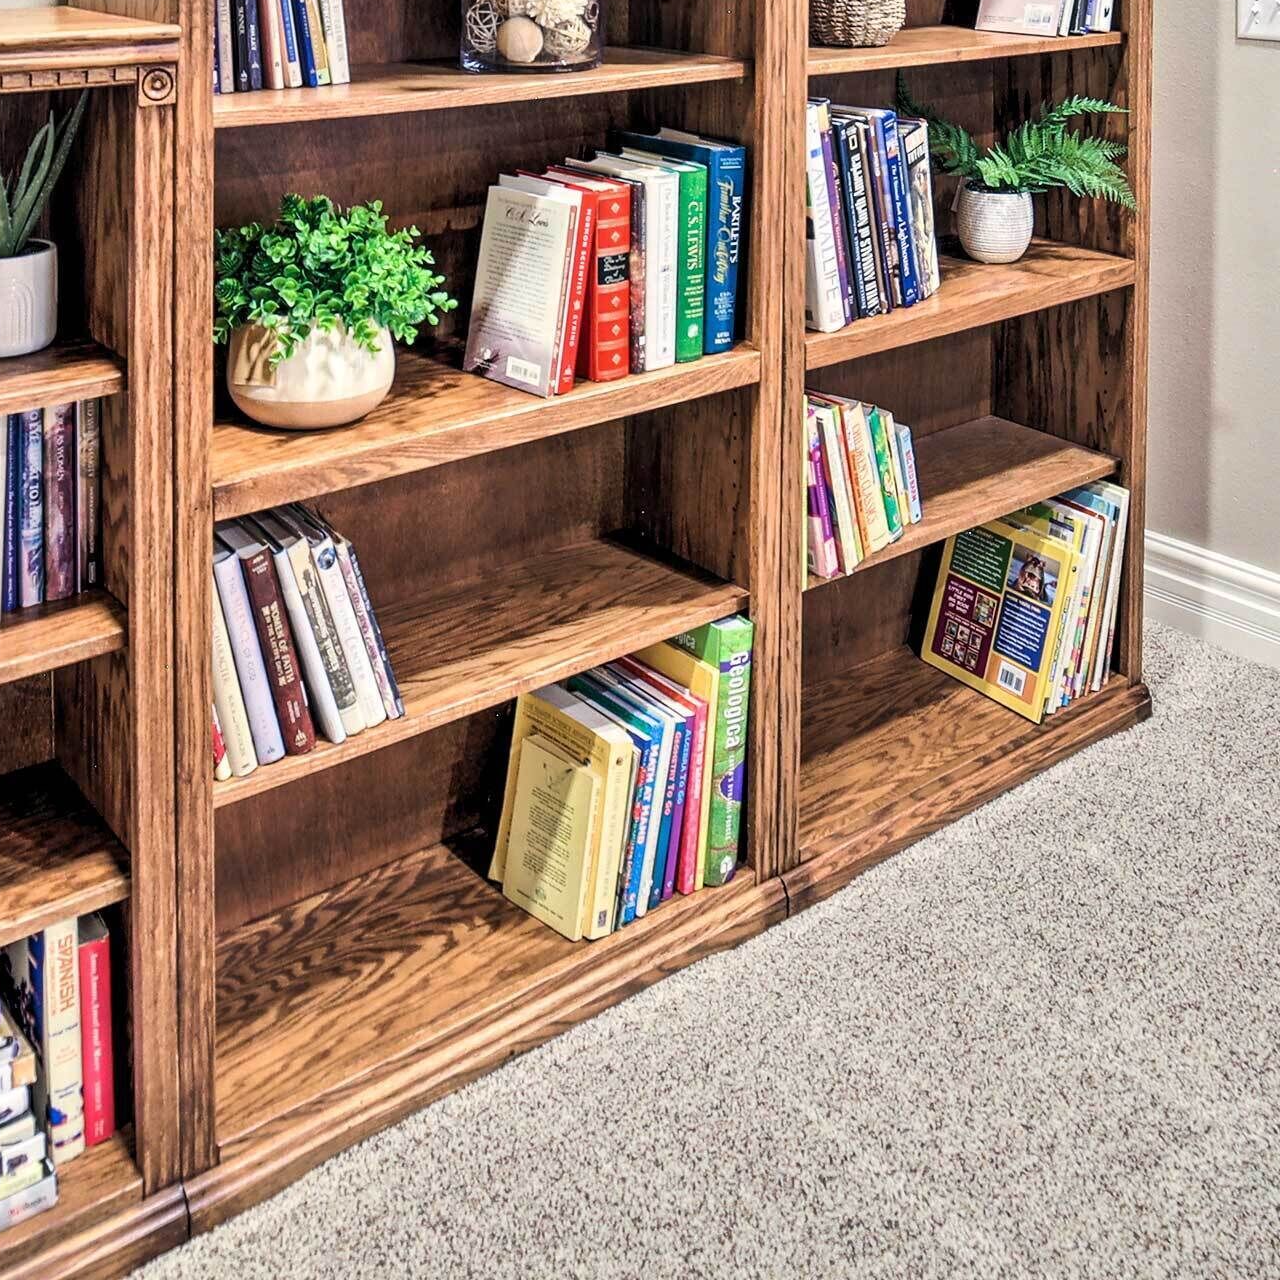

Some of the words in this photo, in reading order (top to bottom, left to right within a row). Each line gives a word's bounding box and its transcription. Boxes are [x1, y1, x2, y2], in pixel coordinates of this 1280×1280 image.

[851, 154, 865, 196] America
[582, 208, 592, 248] MORMON
[854, 198, 868, 226] North
[687, 229, 699, 270] LEWIS
[861, 238, 877, 281] ANIMALS
[896, 222, 912, 277] Lighthouses
[576, 250, 587, 295] SCIENTIST
[865, 283, 880, 309] WILD
[56, 446, 65, 481] WOMEN
[862, 481, 878, 525] CLASSICS
[269, 601, 284, 639] WOMEN
[277, 640, 289, 653] OF
[280, 654, 295, 684] FAITH
[723, 650, 749, 748] Geologica
[645, 743, 660, 783] MATH
[667, 730, 682, 781] GEOMETRY
[679, 729, 692, 772] ALGEBRA
[643, 785, 654, 800] AT
[666, 783, 675, 797] TO
[677, 789, 686, 805] GO
[678, 774, 687, 787] TO
[637, 804, 650, 845] HAND
[663, 800, 673, 816] GO
